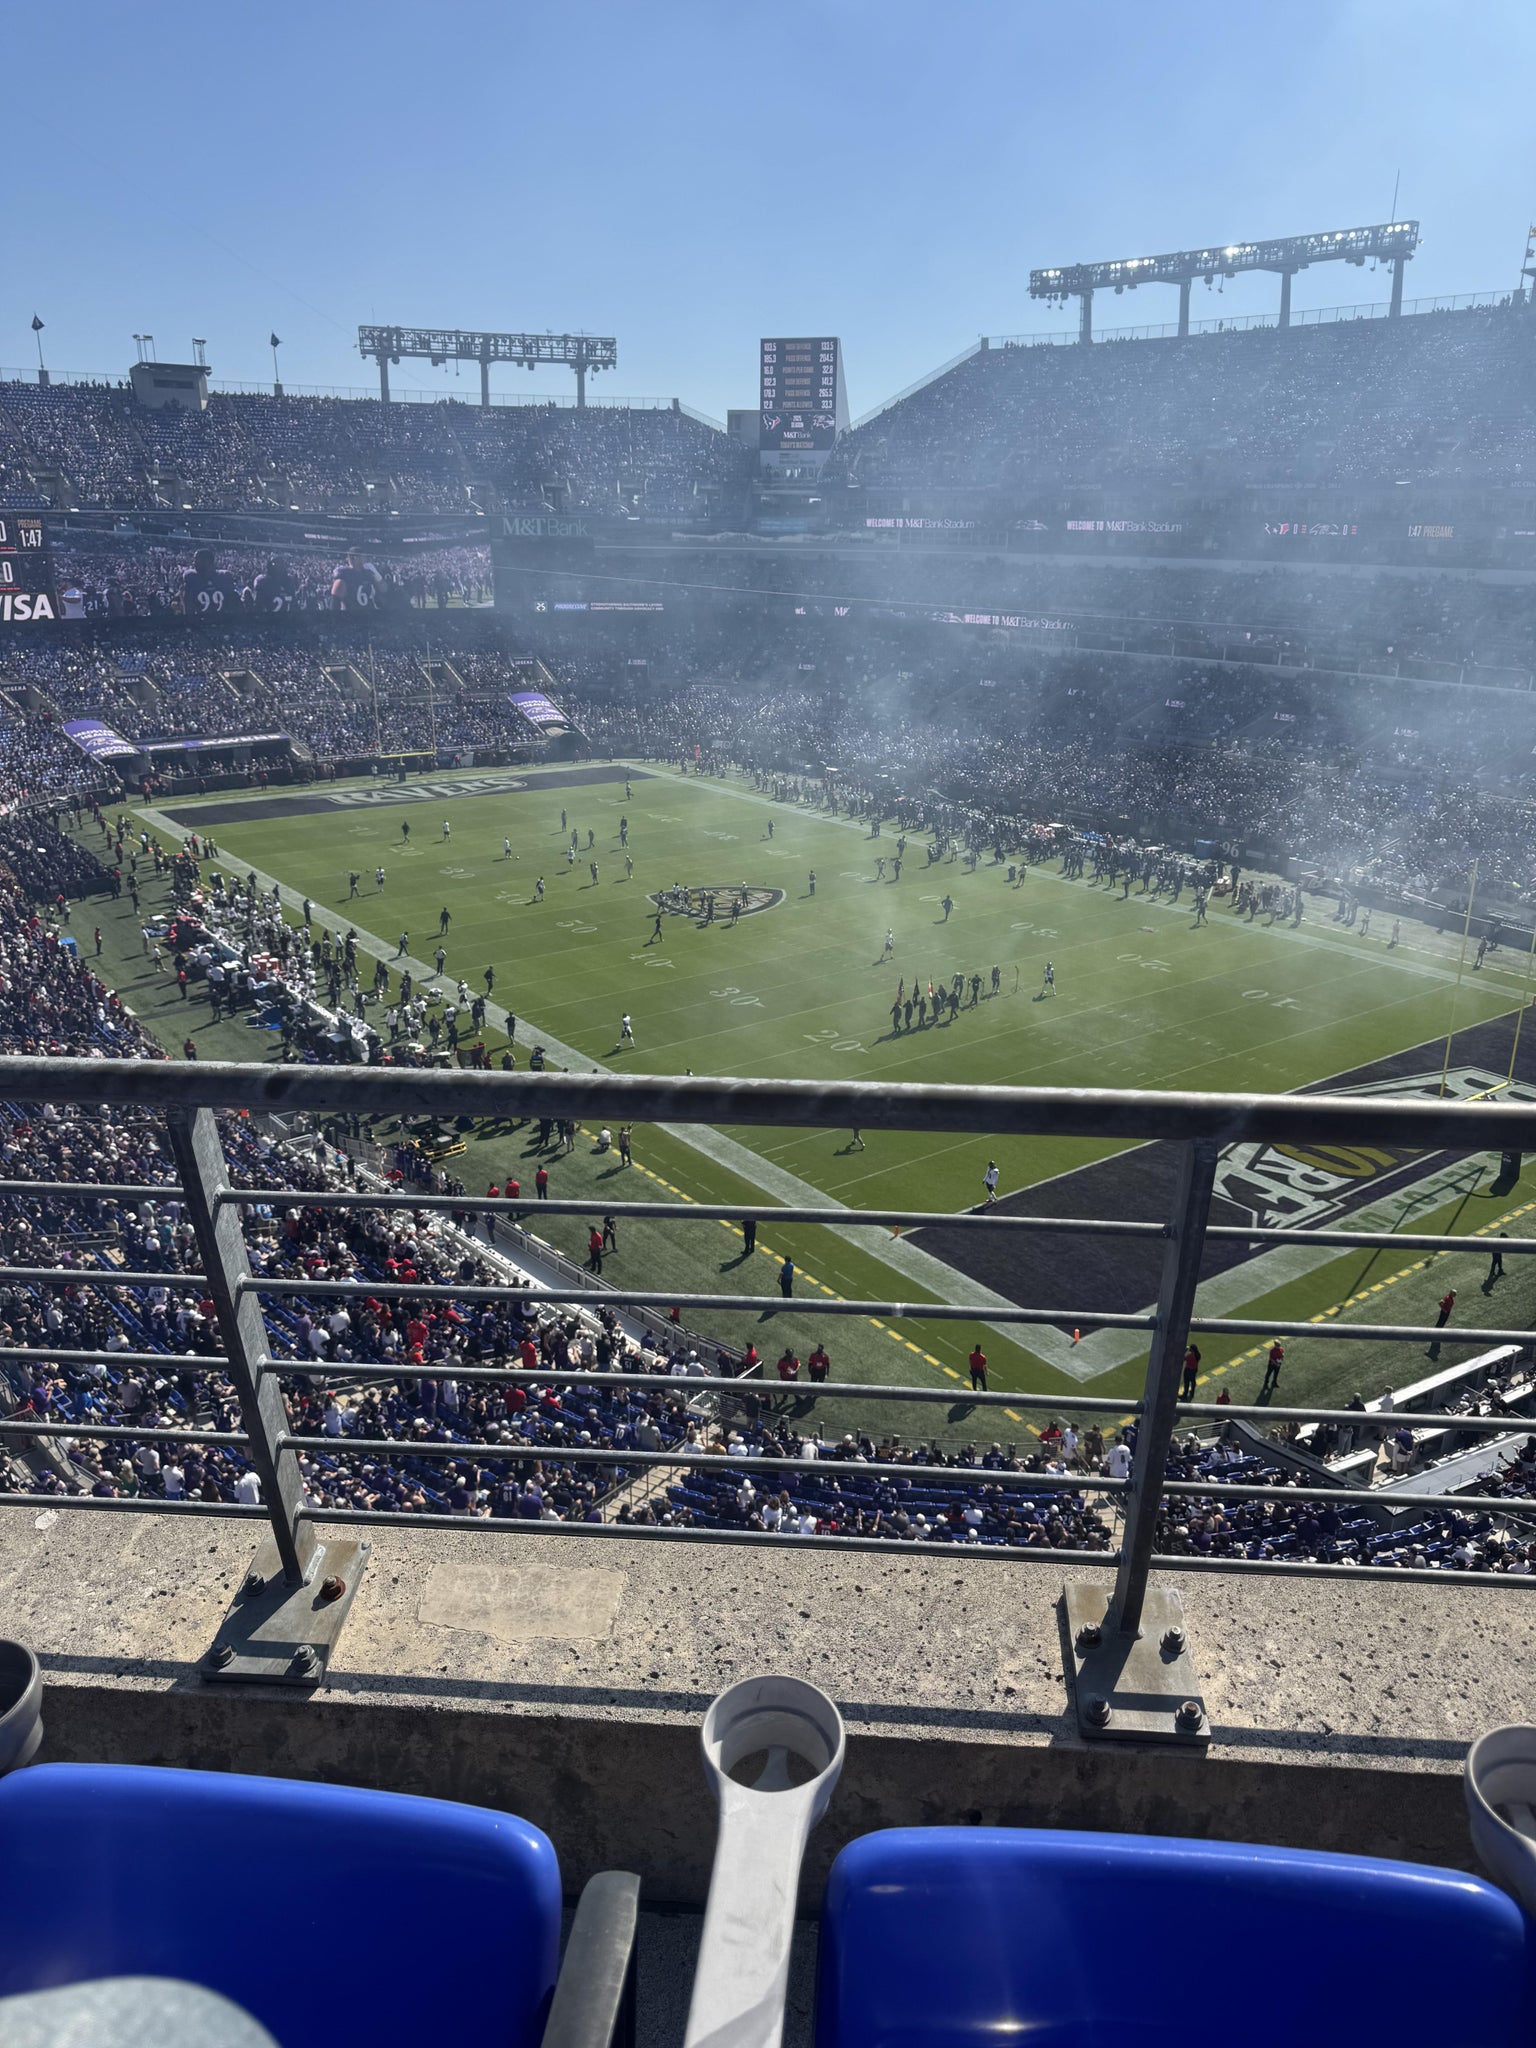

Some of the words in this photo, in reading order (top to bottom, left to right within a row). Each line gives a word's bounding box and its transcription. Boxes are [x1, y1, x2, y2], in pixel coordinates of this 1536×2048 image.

[502, 517, 547, 536] M&T
[548, 518, 588, 537] Bank
[866, 518, 895, 527] WELCOME
[896, 518, 903, 527] TO
[905, 519, 924, 528] M&T
[924, 519, 944, 528] Bank
[944, 519, 975, 528] Stadium
[1067, 520, 1095, 530] WELCOME
[1096, 520, 1104, 530] TO
[1106, 521, 1125, 531] M&T
[1126, 521, 1146, 532] Bank
[1148, 521, 1182, 532] Stadium
[20, 530, 42, 547] 1:47
[2, 562, 13, 583] 0
[0, 594, 55, 621] ISA
[198, 591, 224, 612] 99
[964, 614, 991, 624] WELCOME
[992, 616, 1000, 625] TO
[1001, 616, 1019, 626] M&T
[1020, 617, 1040, 628] Bank
[328, 778, 524, 804] RAVENS
[1222, 842, 1239, 858] 96
[709, 987, 759, 1006] 30
[803, 1030, 861, 1051] 20
